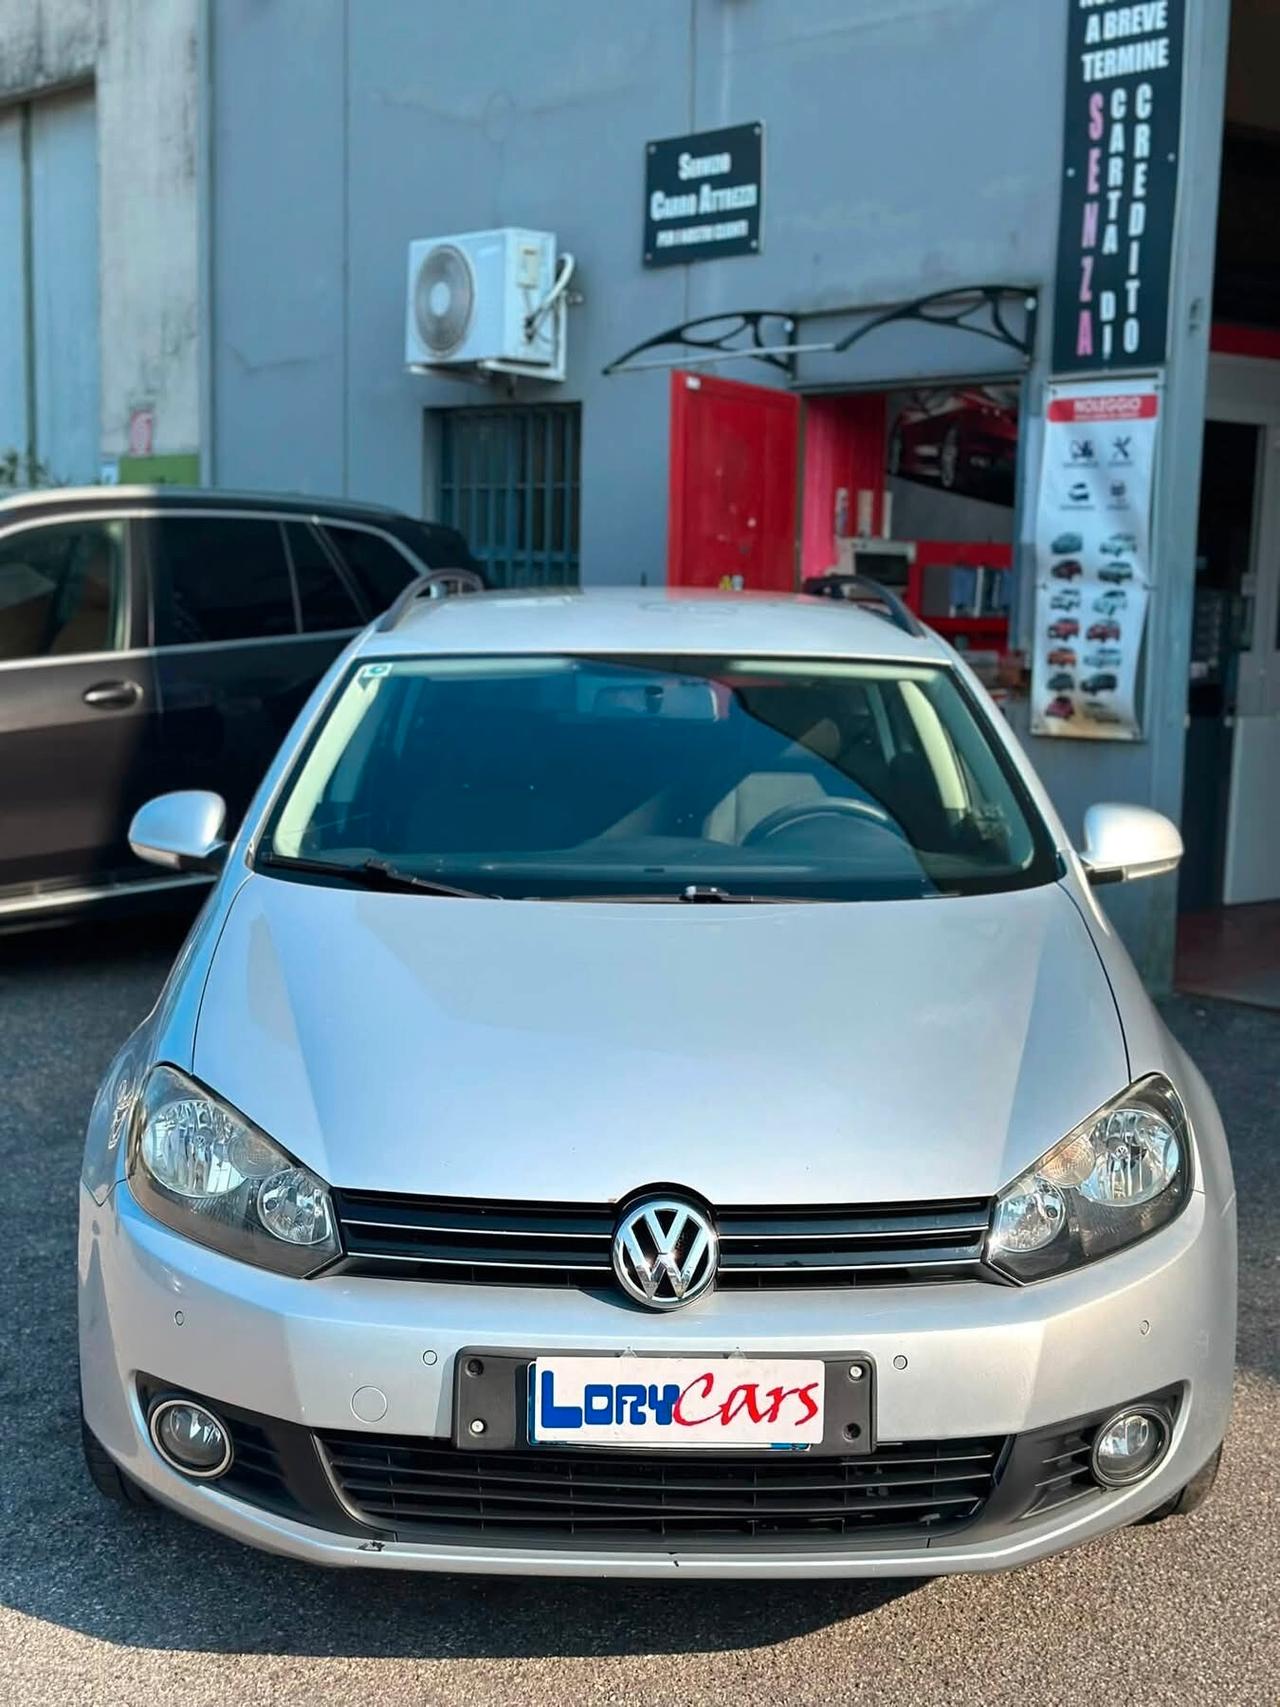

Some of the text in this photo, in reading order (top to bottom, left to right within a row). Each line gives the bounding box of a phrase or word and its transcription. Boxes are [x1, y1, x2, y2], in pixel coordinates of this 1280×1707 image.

[1081, 37, 1169, 82] TERMINE
[1084, 0, 1168, 44] A BREVE
[1077, 92, 1104, 356] SENZA
[1099, 88, 1127, 360] CARTA DI
[1122, 83, 1153, 353] CREDITO
